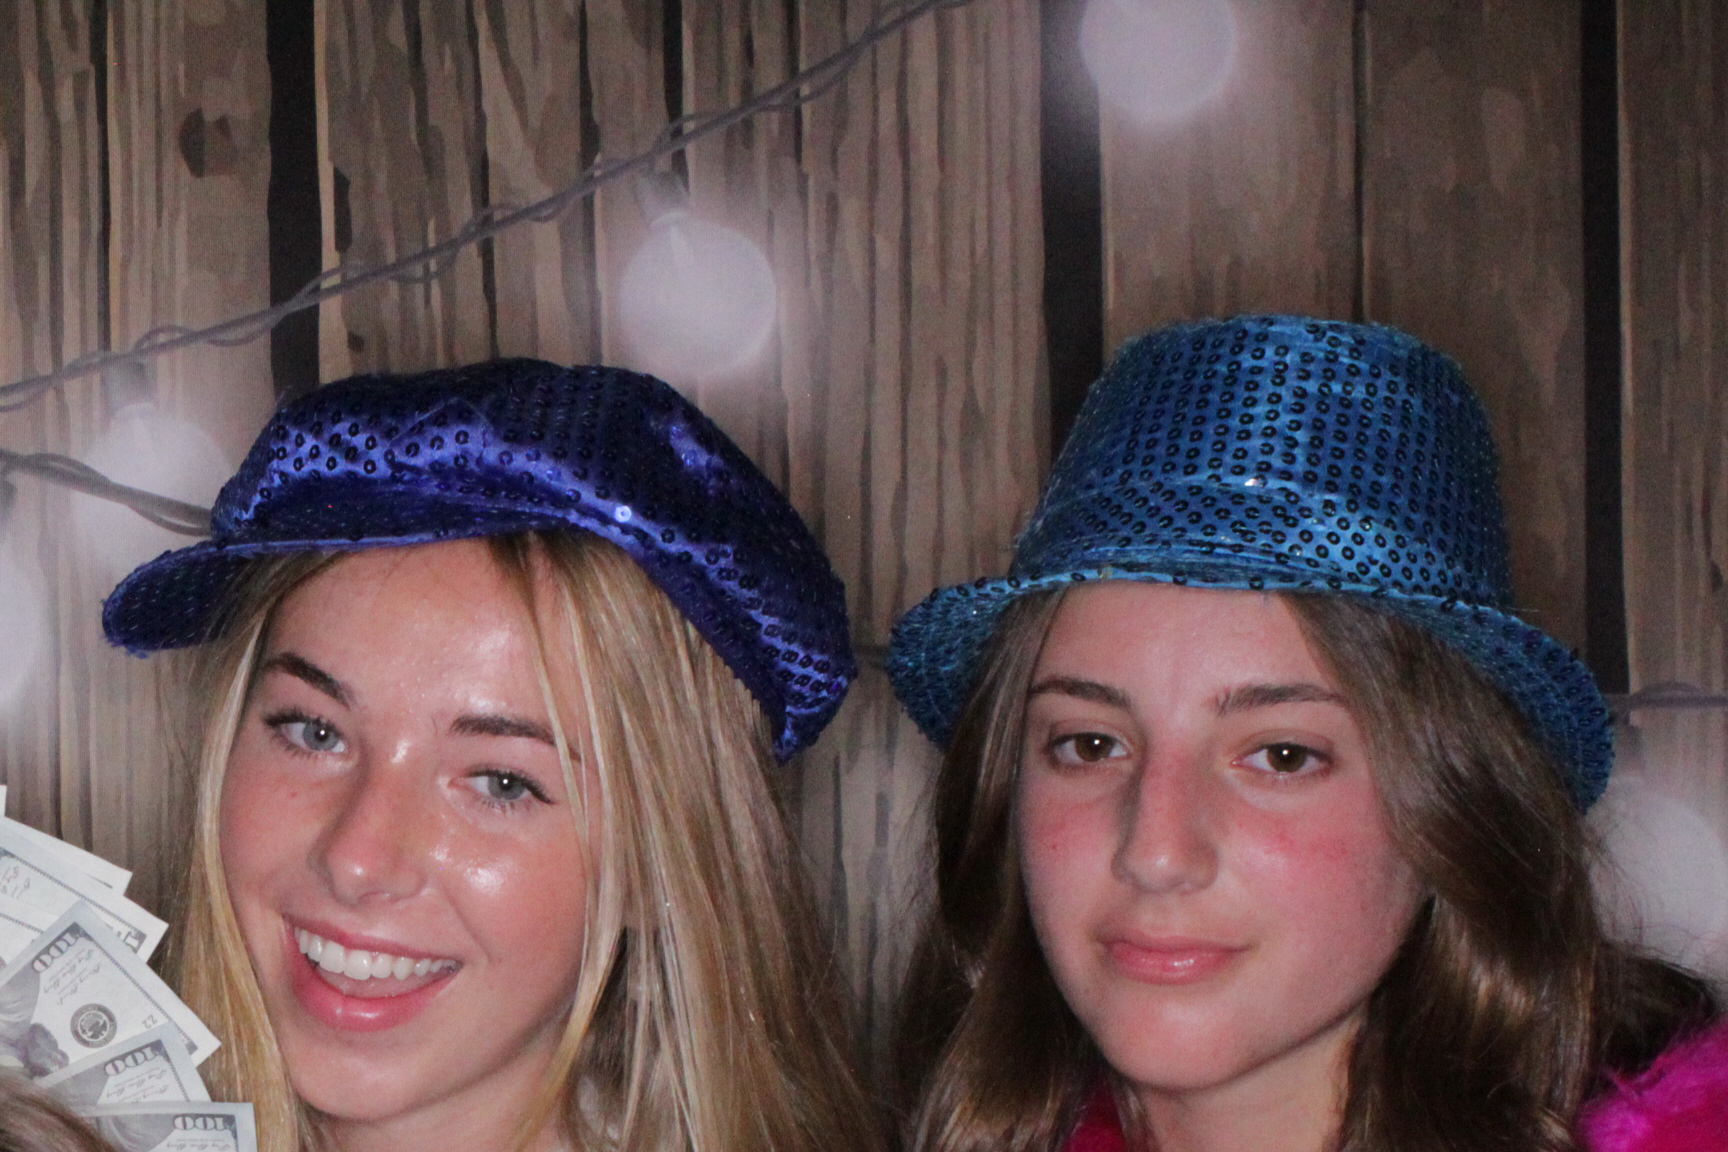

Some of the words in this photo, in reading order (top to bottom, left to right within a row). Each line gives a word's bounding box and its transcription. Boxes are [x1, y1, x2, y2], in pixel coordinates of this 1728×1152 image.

[31, 931, 81, 973] 100
[103, 1046, 156, 1077] 100
[173, 1115, 226, 1131] 100
